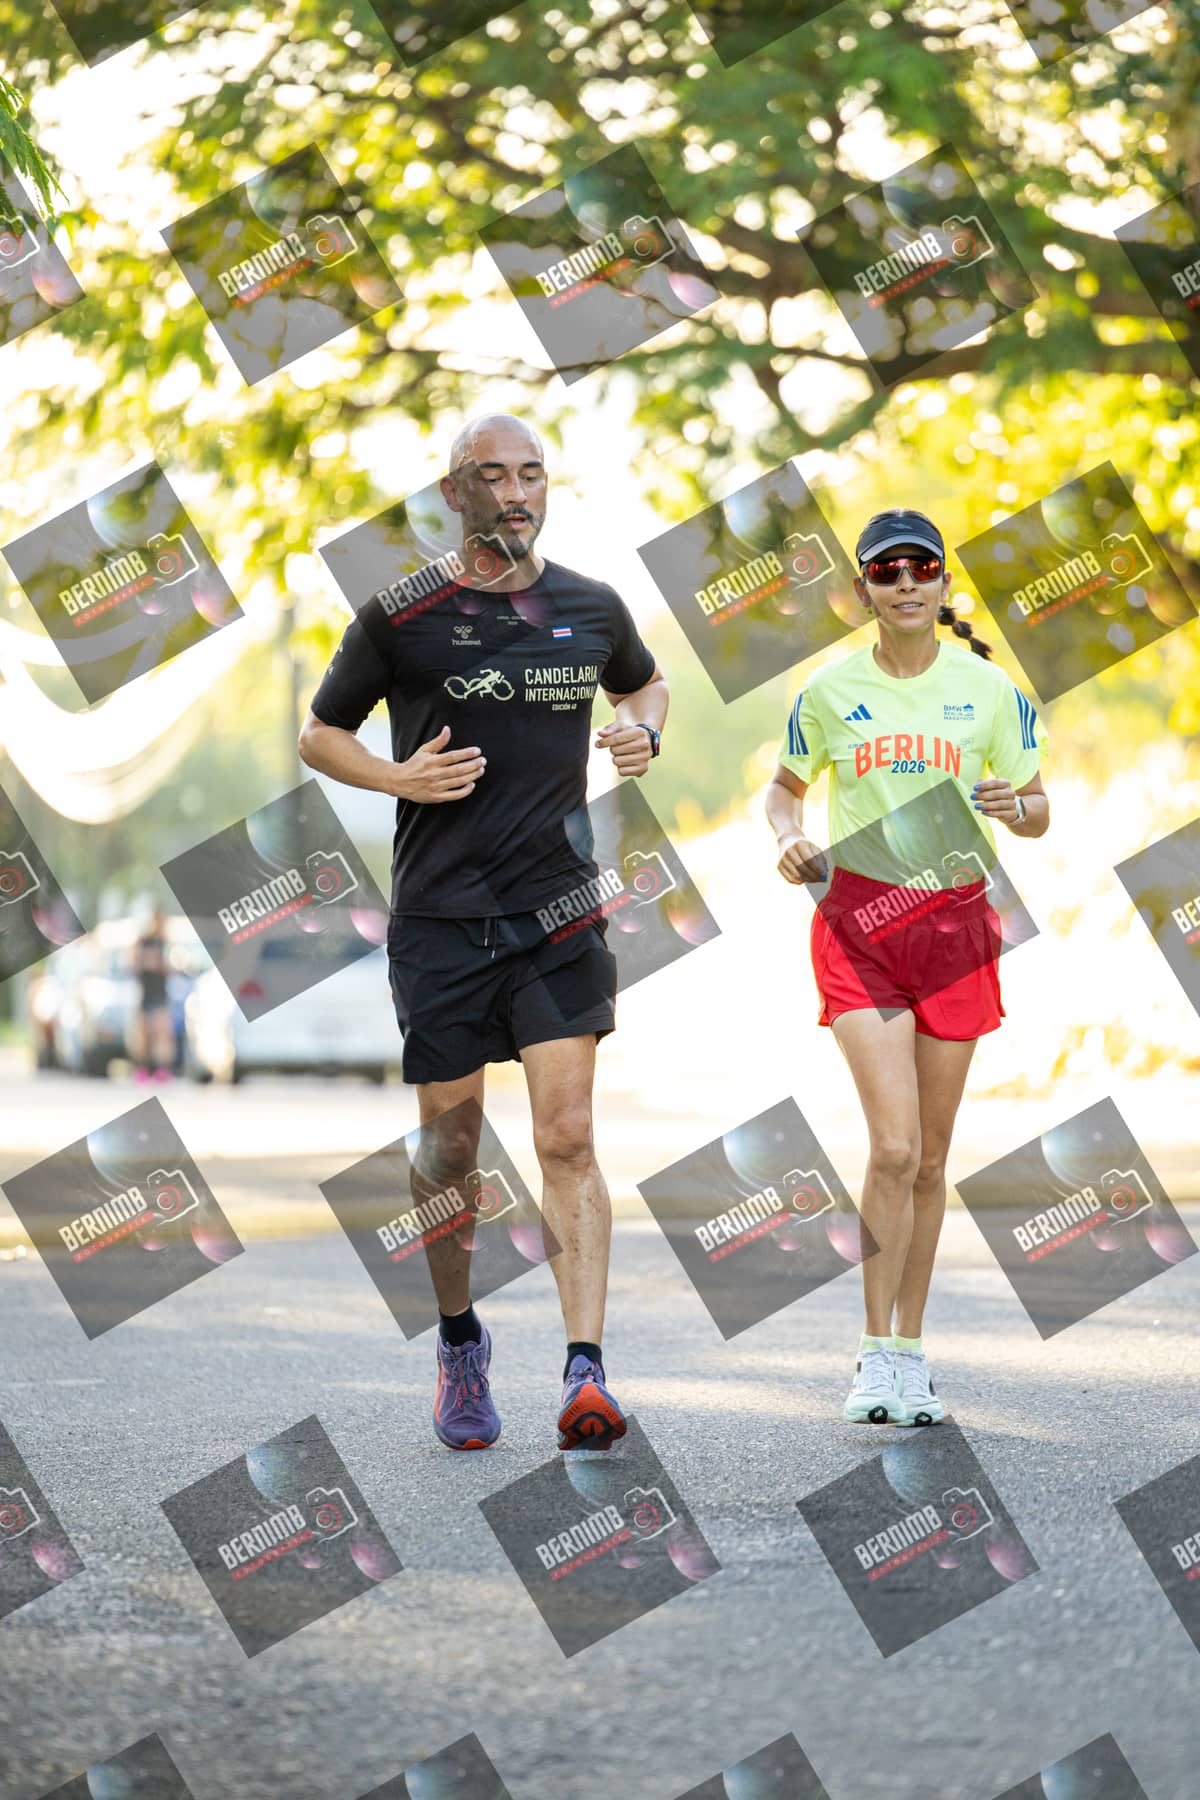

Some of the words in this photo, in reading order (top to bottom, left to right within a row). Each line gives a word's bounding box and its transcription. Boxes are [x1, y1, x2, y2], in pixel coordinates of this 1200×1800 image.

[524, 665, 598, 685] CANDELARIA
[855, 733, 961, 779] BERLIN
[891, 760, 926, 774] 2026
